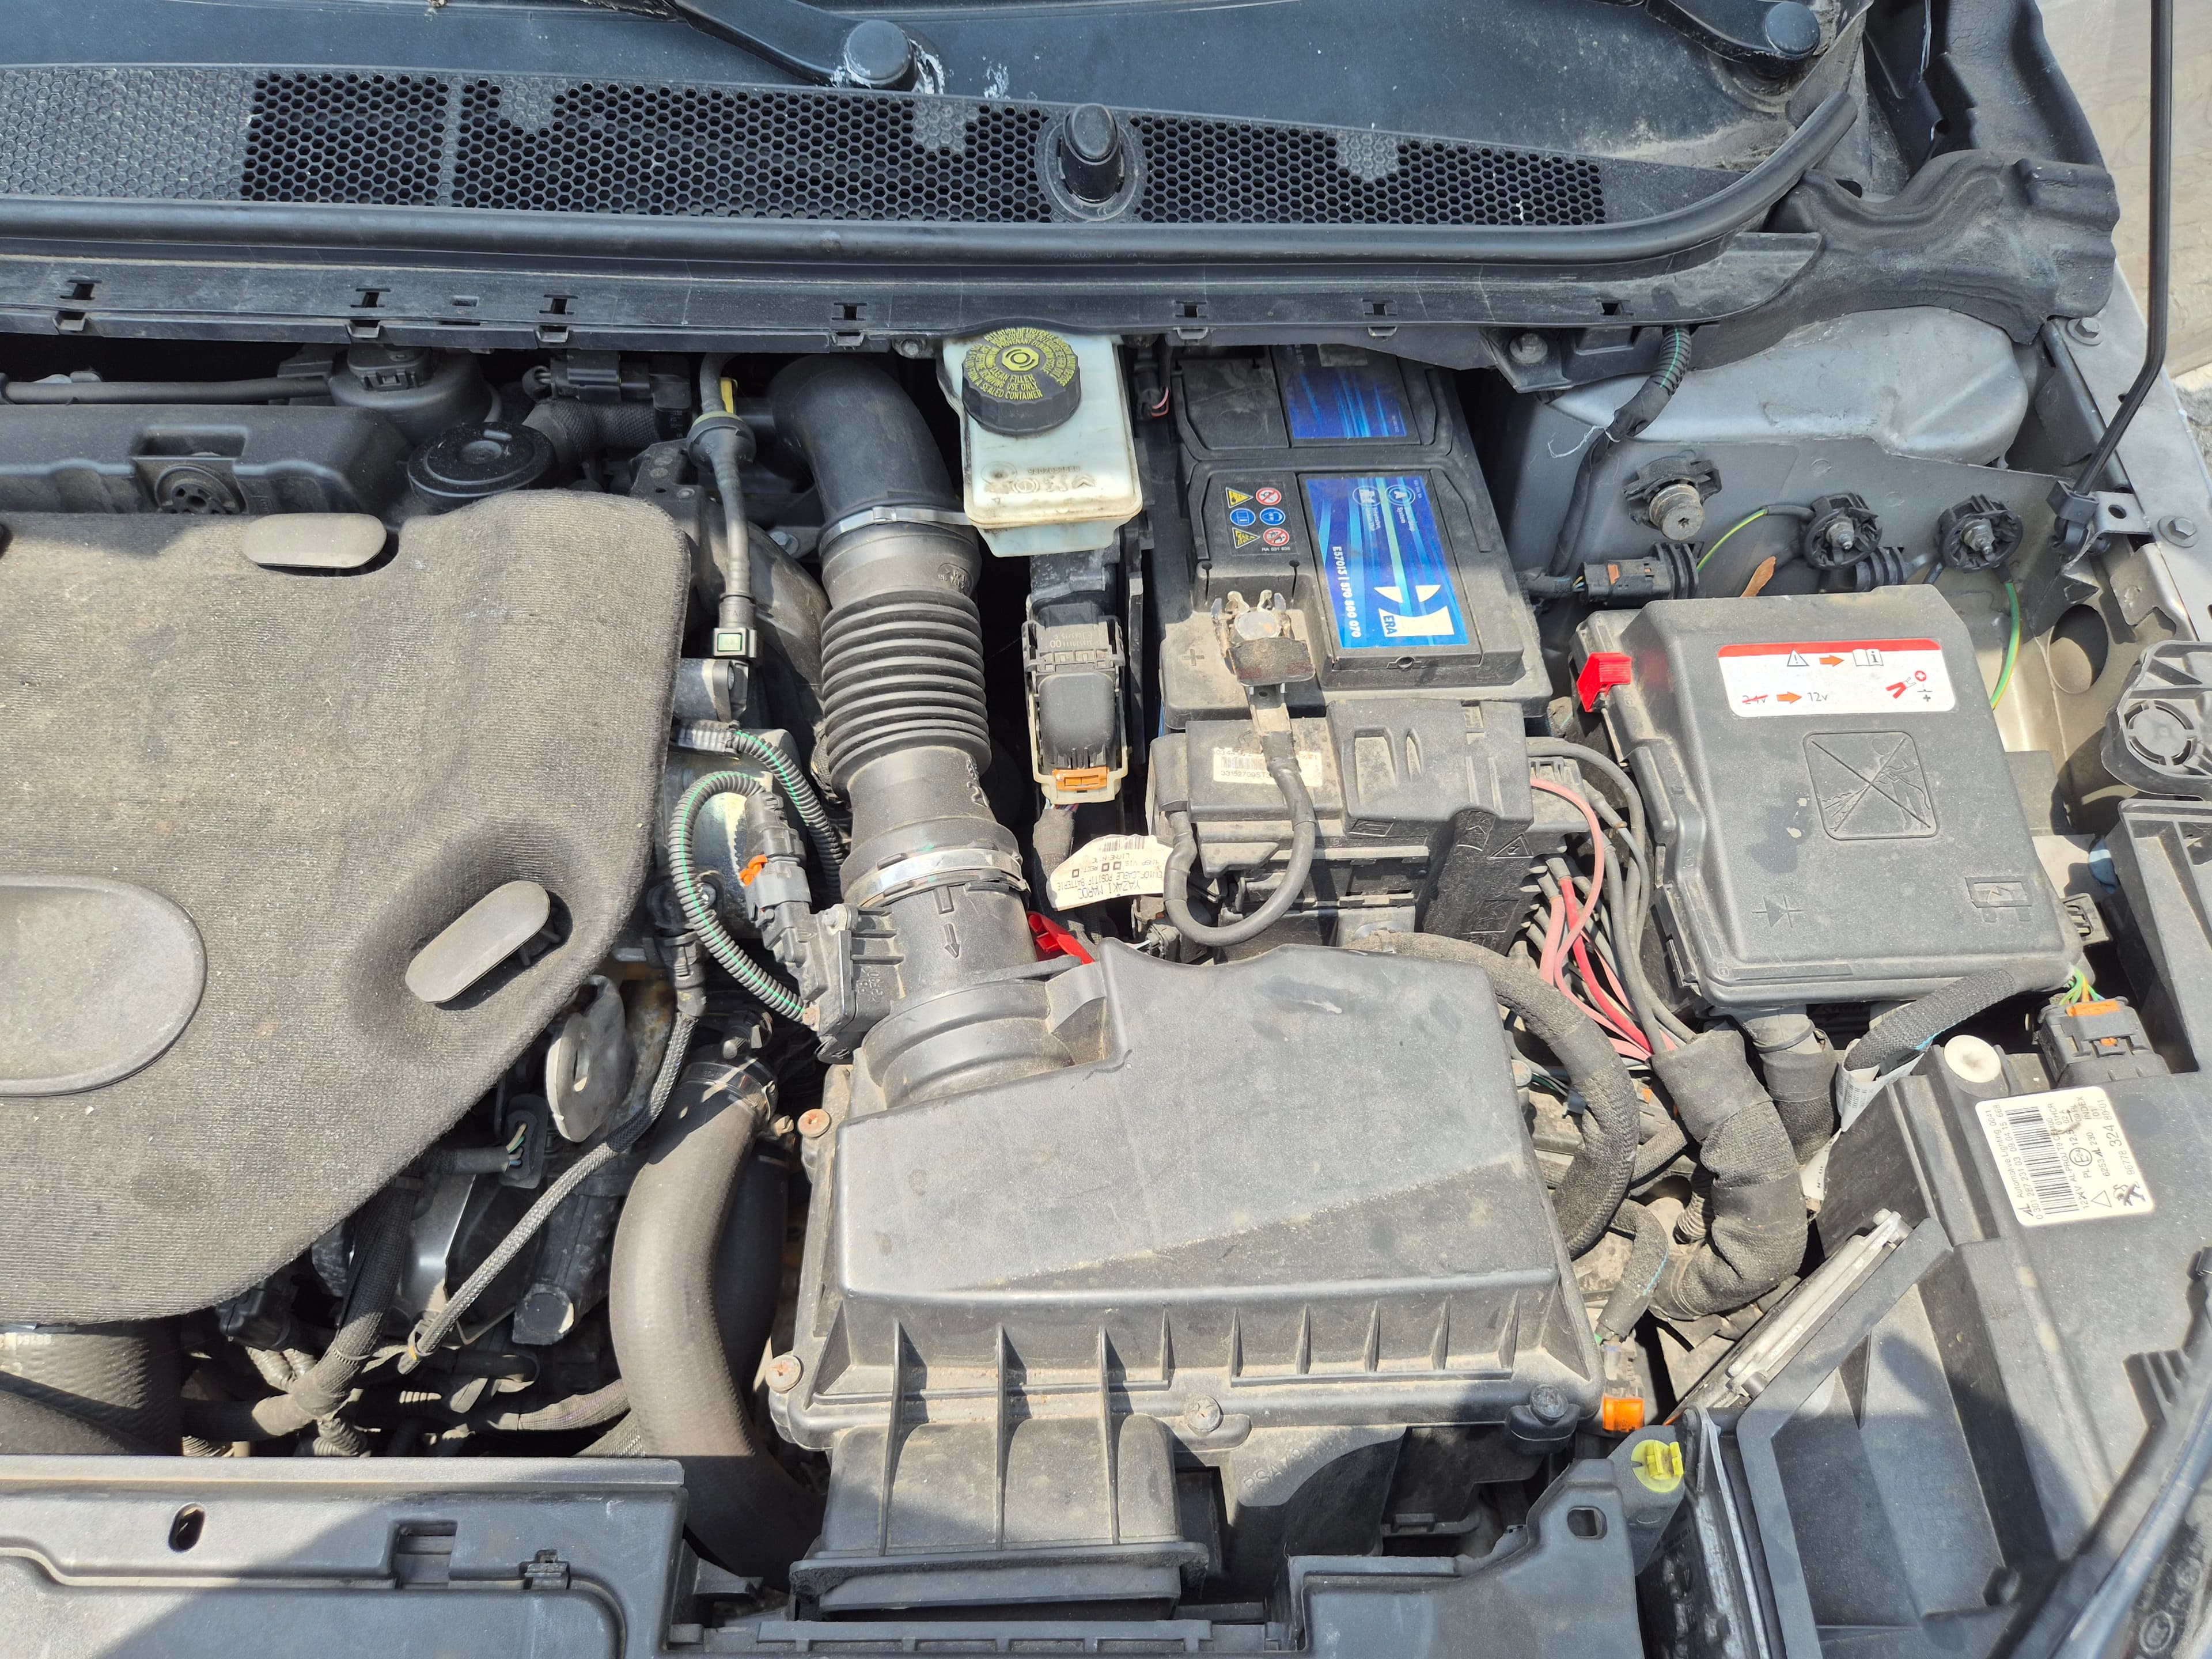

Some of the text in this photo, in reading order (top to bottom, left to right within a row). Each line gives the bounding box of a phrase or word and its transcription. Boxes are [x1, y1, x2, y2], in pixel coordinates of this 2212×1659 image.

[1007, 383, 1019, 391] USE
[1021, 382, 1037, 391] ONLY
[1010, 375, 1035, 383] FILLER
[980, 383, 1004, 397] SEALED
[1005, 389, 1043, 400] CONTAINER
[1396, 507, 1406, 524] System
[1332, 546, 1361, 638] E57013 570 500 070
[1383, 615, 1397, 635] ERA
[1807, 692, 1828, 702] 12v
[1057, 878, 1085, 891] BATTERIE
[1088, 873, 1113, 885] POSITIF
[1078, 881, 1140, 899] YAZAKI MAROC
[2076, 1096, 2090, 1120] INDEX
[2090, 1108, 2100, 1117] 01
[1985, 1110, 1997, 1126] 0041
[1994, 1129, 2009, 1157] Lighting
[2000, 1122, 2017, 1152] 09.04.15
[2086, 1132, 2097, 1146] 230
[2097, 1100, 2135, 1175] 96778 324 80-01
[2056, 1142, 2065, 1151] T9
[2013, 1157, 2022, 1166] 03
[2061, 1152, 2077, 1182] AL-PROJ
[2097, 1158, 2111, 1176] 6253
[2005, 1159, 2024, 1198] Automotive
[2018, 1169, 2028, 1181] 231
[2082, 1168, 2092, 1179] PL
[2023, 1184, 2035, 1196] 287
[2031, 1200, 2041, 1213] 301
